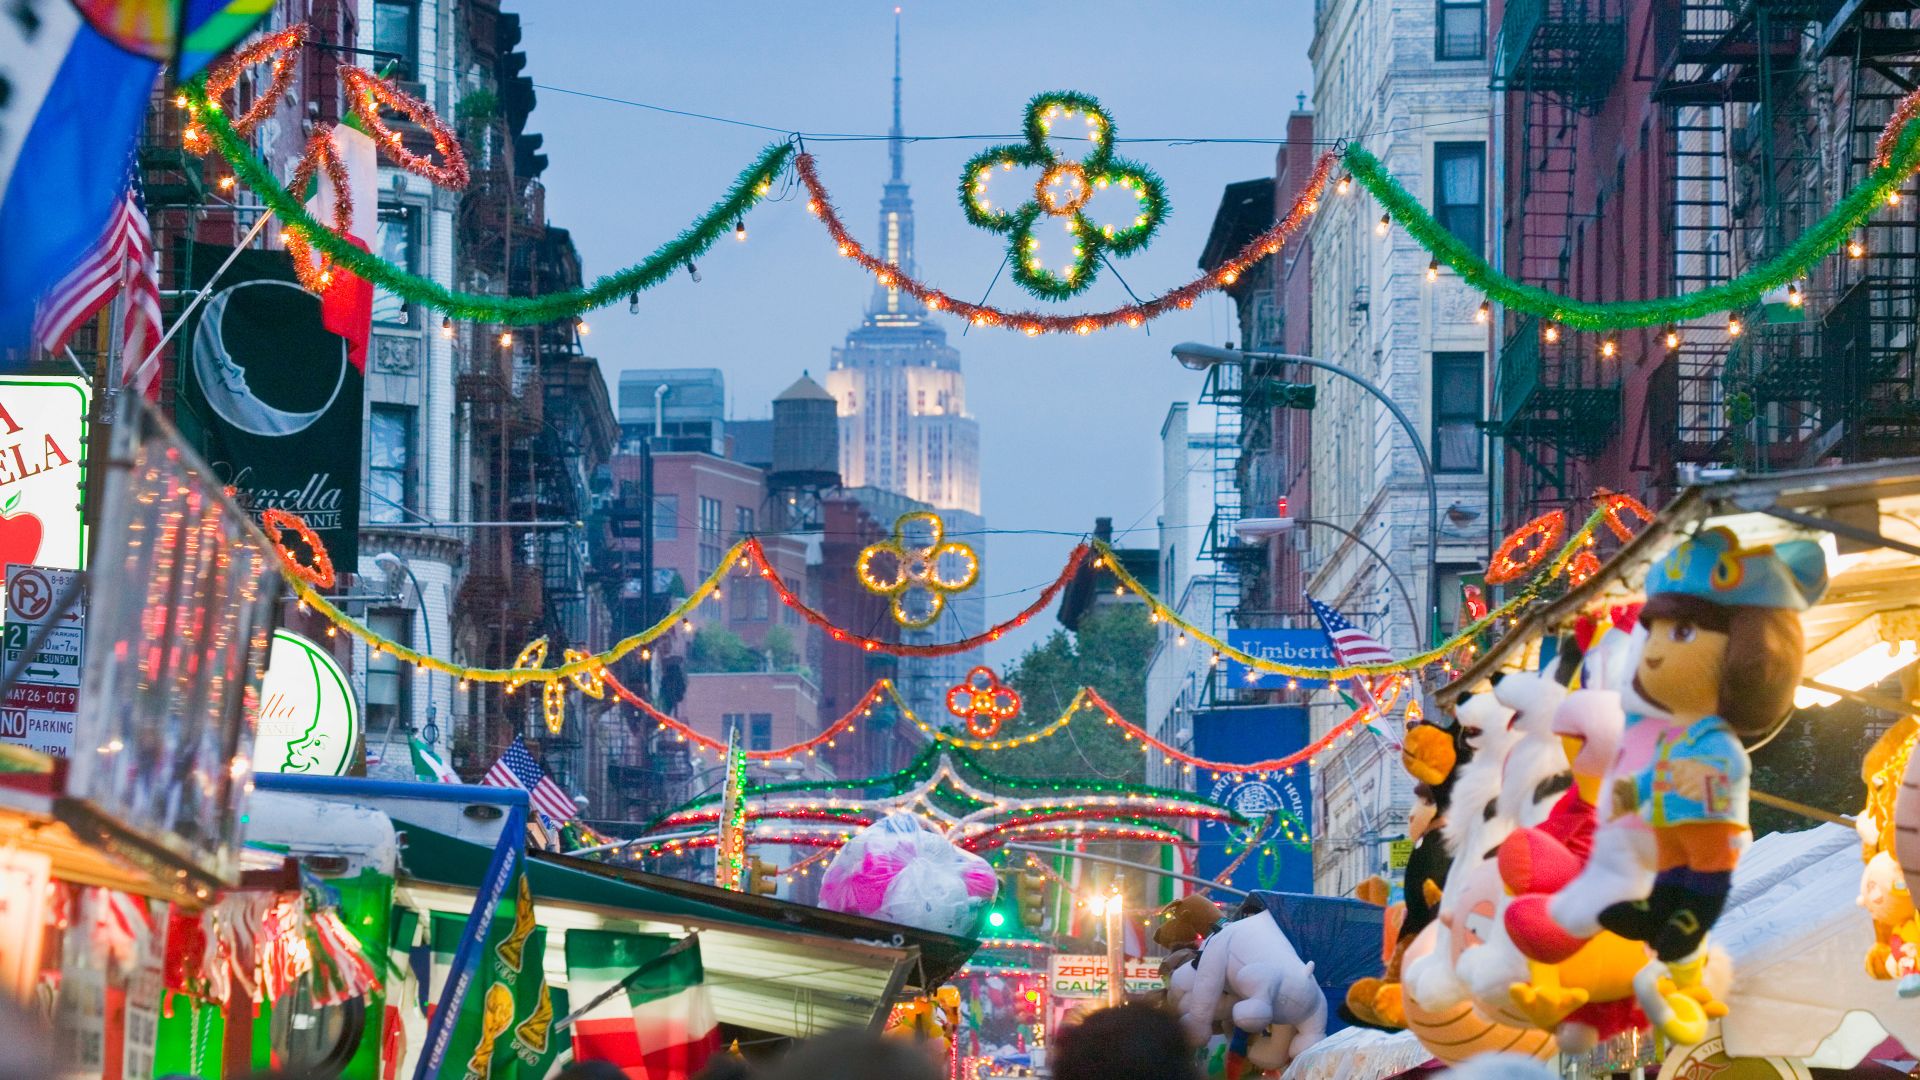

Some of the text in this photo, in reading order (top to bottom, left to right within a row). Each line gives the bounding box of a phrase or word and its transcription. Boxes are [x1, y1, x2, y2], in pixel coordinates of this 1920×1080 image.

[9, 624, 22, 648] 2
[43, 653, 75, 665] SUNDAY
[6, 688, 26, 701] MAY
[68, 692, 75, 705] 9
[1, 710, 73, 736] NO PARKING
[1058, 966, 1161, 979] ZEPPLES
[1056, 981, 1162, 993] CALZNES
[428, 972, 469, 1070] FORZA AZZURRI
